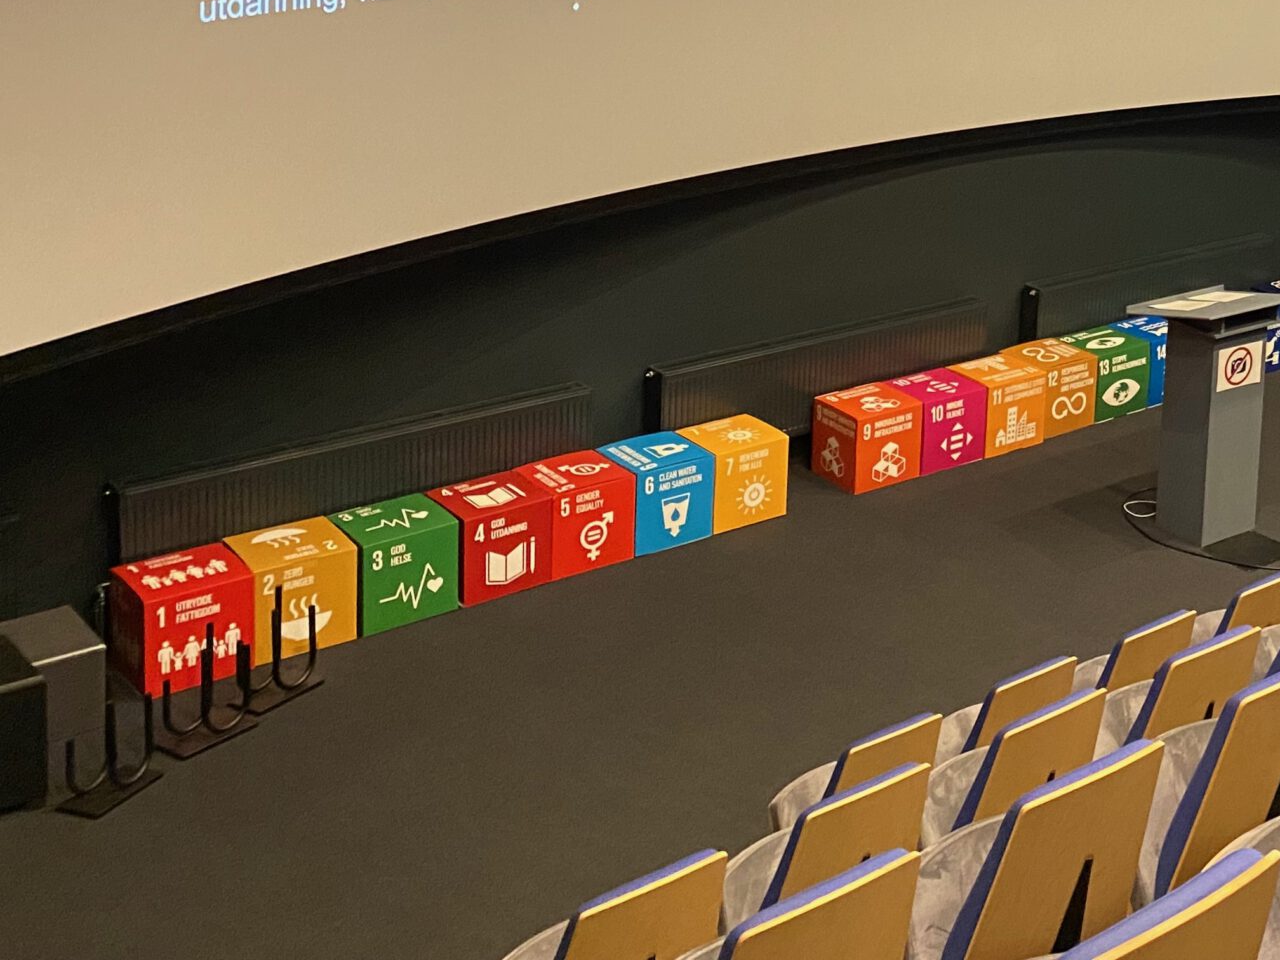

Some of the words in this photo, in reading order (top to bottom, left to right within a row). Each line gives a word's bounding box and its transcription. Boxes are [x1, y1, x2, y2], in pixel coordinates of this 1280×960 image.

[1099, 359, 1109, 375] 13
[1048, 370, 1058, 387] 12
[993, 388, 1001, 405] 11
[931, 405, 943, 423] 10
[863, 424, 871, 440] 9
[659, 470, 678, 482] CLEAN
[726, 458, 734, 476] 7
[645, 476, 654, 495] 6
[561, 497, 570, 517] 5
[474, 523, 485, 542] 4
[391, 544, 406, 555] GOD
[372, 550, 383, 571] 3
[391, 552, 412, 567] HELSE
[263, 574, 275, 596] 2
[156, 606, 165, 628] 1
